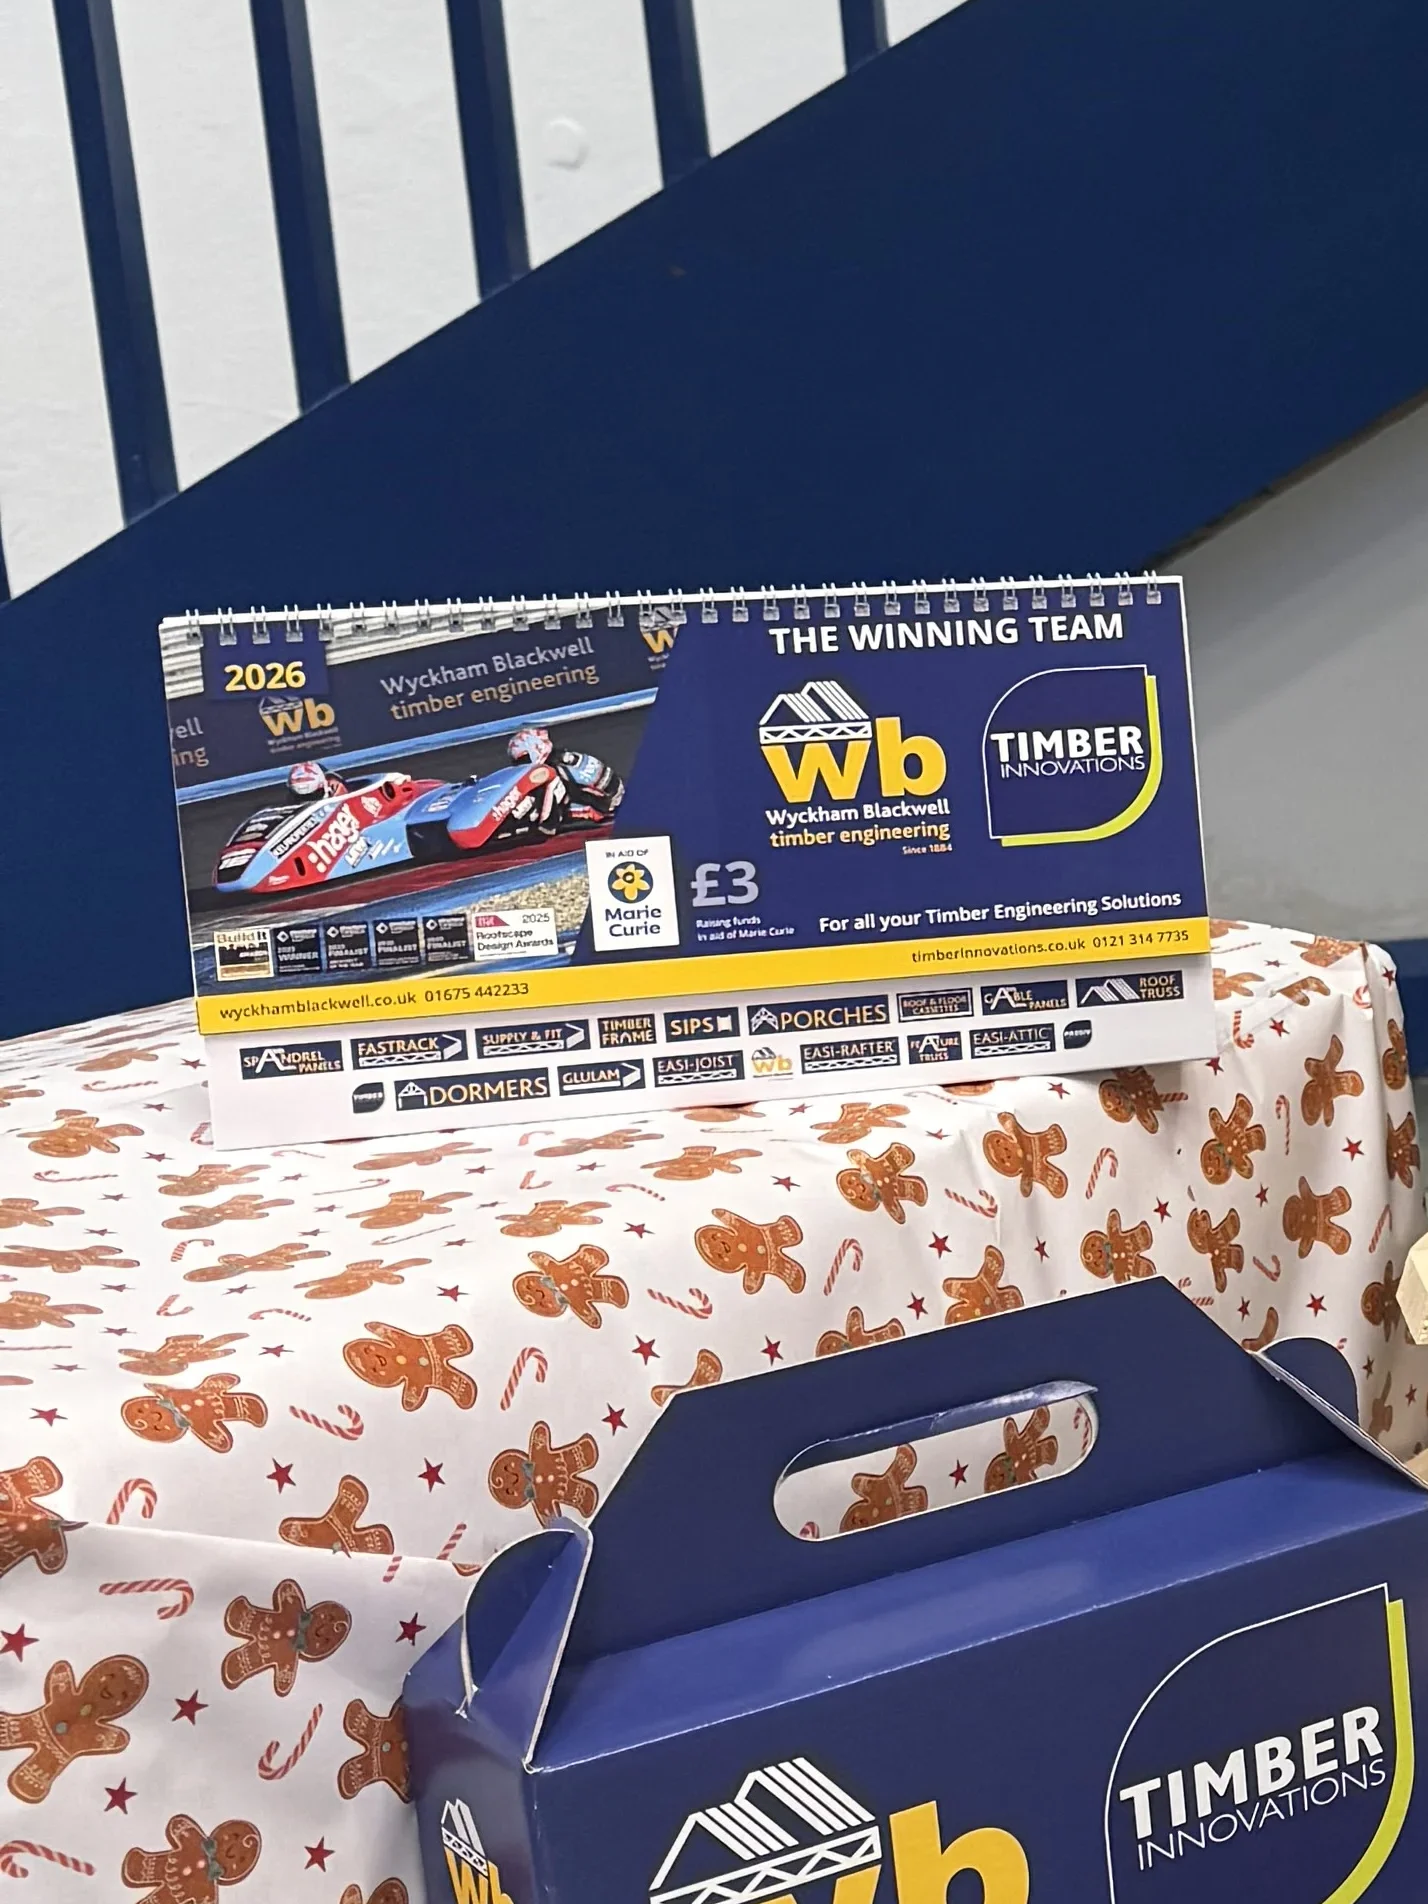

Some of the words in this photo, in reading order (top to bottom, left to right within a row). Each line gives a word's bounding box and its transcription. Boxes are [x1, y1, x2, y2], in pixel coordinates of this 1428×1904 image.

[769, 624, 839, 655] THE
[847, 617, 1019, 651] WINNING
[1028, 613, 1124, 642] TEAM
[224, 660, 306, 692] 2026
[380, 661, 489, 696] Wyckham
[492, 636, 595, 673] Blackwell
[390, 690, 463, 721] timber
[471, 664, 600, 703] engineering
[990, 725, 1144, 763] TIMBER
[761, 717, 948, 803] wb
[1000, 754, 1146, 779] INNOVATIONS
[766, 805, 860, 831] Wyckham
[863, 798, 951, 818] Blackwell
[770, 827, 836, 848] timber
[839, 821, 951, 846] engineering
[902, 844, 928, 856] Since
[690, 860, 760, 908] £3
[605, 904, 662, 922] Marie
[696, 917, 732, 930] Raising
[733, 915, 761, 927] funds
[819, 917, 850, 933] For
[853, 913, 876, 931] all
[879, 914, 922, 933] your
[926, 907, 989, 925] Timber
[994, 899, 1098, 922] Engineering
[1101, 891, 1182, 912] Solutions
[609, 920, 661, 938] Curie
[709, 930, 725, 941] aid
[726, 929, 738, 940] of
[738, 928, 767, 940] Marie
[768, 926, 795, 938] Curie
[911, 938, 1086, 964] timberinnovations.co.uk
[1092, 932, 1125, 950] 0121
[1128, 931, 1154, 947] 314
[1157, 929, 1190, 945] 7735
[1138, 974, 1176, 988] ROOF
[219, 992, 418, 1022] wyckhamblackwell.co.uk
[424, 987, 471, 1003] 01675
[474, 982, 530, 1000] 442233
[984, 986, 1033, 1011] GABLE
[1028, 997, 1068, 1011] PANELS
[1139, 986, 1182, 1000] TRUSS
[601, 1017, 653, 1032] TIMBER
[670, 1019, 714, 1036] SIPS
[780, 1004, 887, 1031] PORCHES
[357, 1036, 440, 1057] FASTRACK
[482, 1032, 527, 1046] SUPPLY
[530, 1030, 542, 1042] &
[601, 1030, 654, 1046] FRAME
[972, 1027, 1049, 1046] EASI-ATTIC
[243, 1048, 325, 1074] SPANDREL
[802, 1040, 895, 1060] EASI-RAFTER
[297, 1059, 342, 1074] PANELS
[656, 1054, 734, 1073] EASI-JOIST
[753, 1055, 793, 1073] wb
[562, 1068, 621, 1086] GLULAM
[429, 1075, 549, 1106] DORMERS
[1118, 1704, 1386, 1819] TIMBER
[1137, 1758, 1388, 1871] INNOVATIONS
